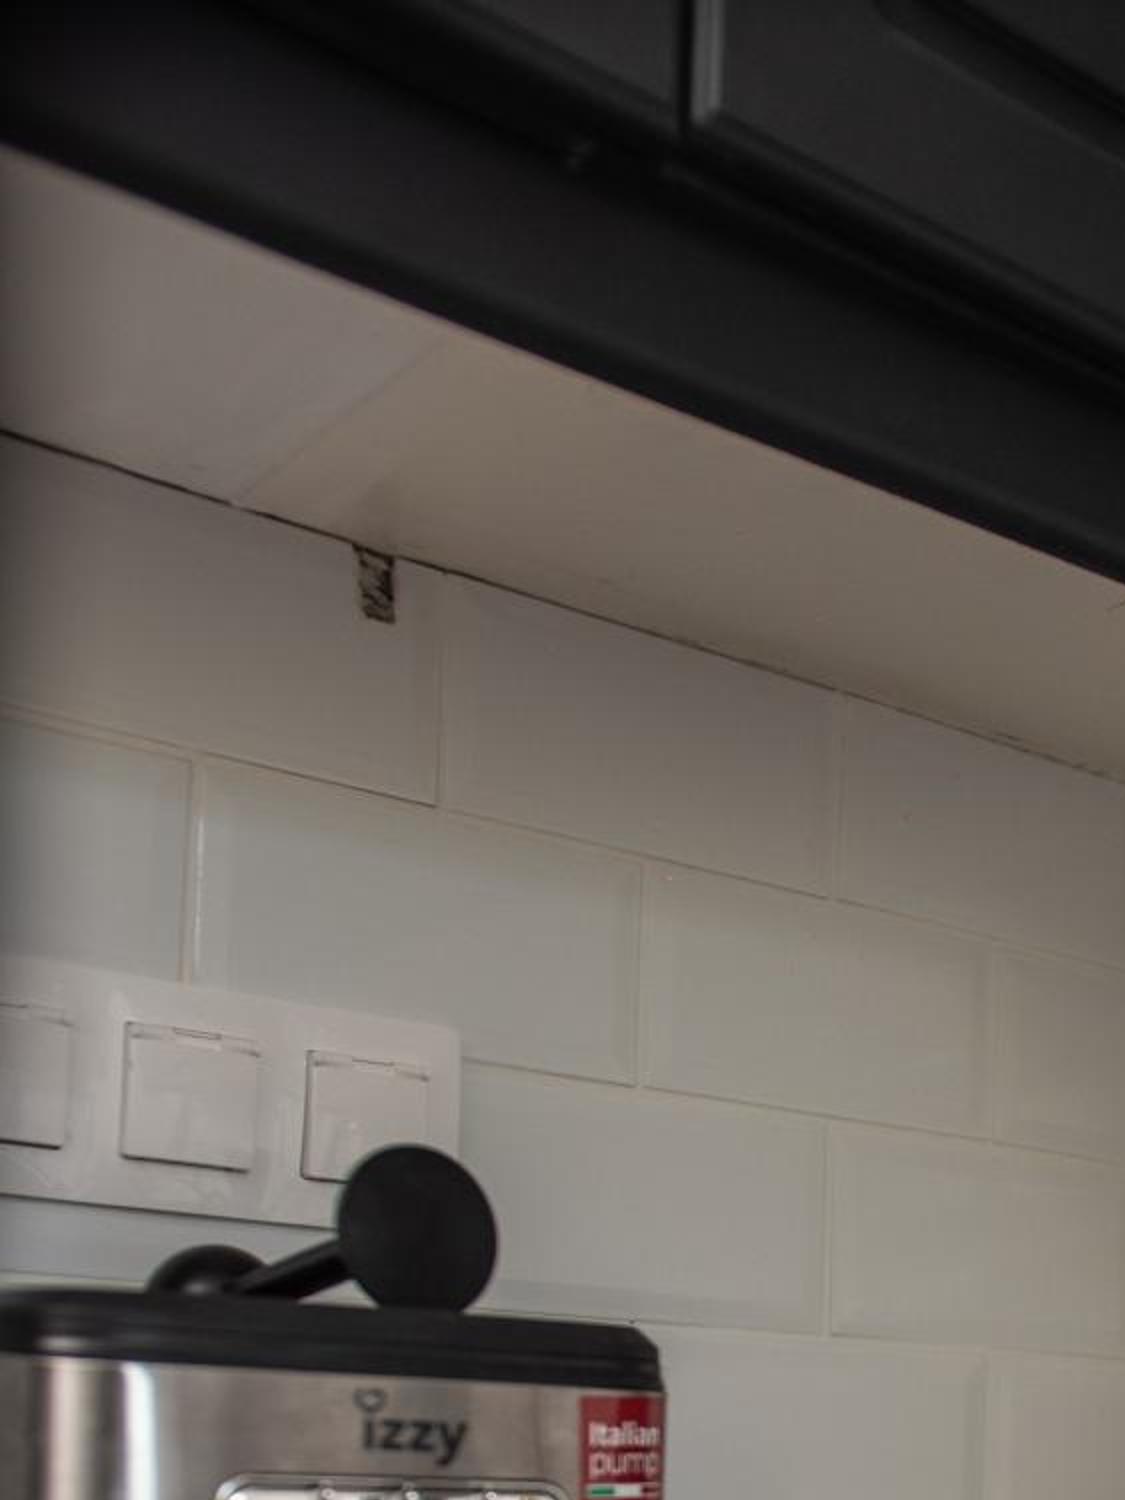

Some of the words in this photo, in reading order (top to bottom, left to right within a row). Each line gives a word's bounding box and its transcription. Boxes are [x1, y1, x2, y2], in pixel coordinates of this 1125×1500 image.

[355, 1388, 468, 1467] izzy
[589, 1421, 661, 1447] Italian
[589, 1452, 660, 1480] pump
